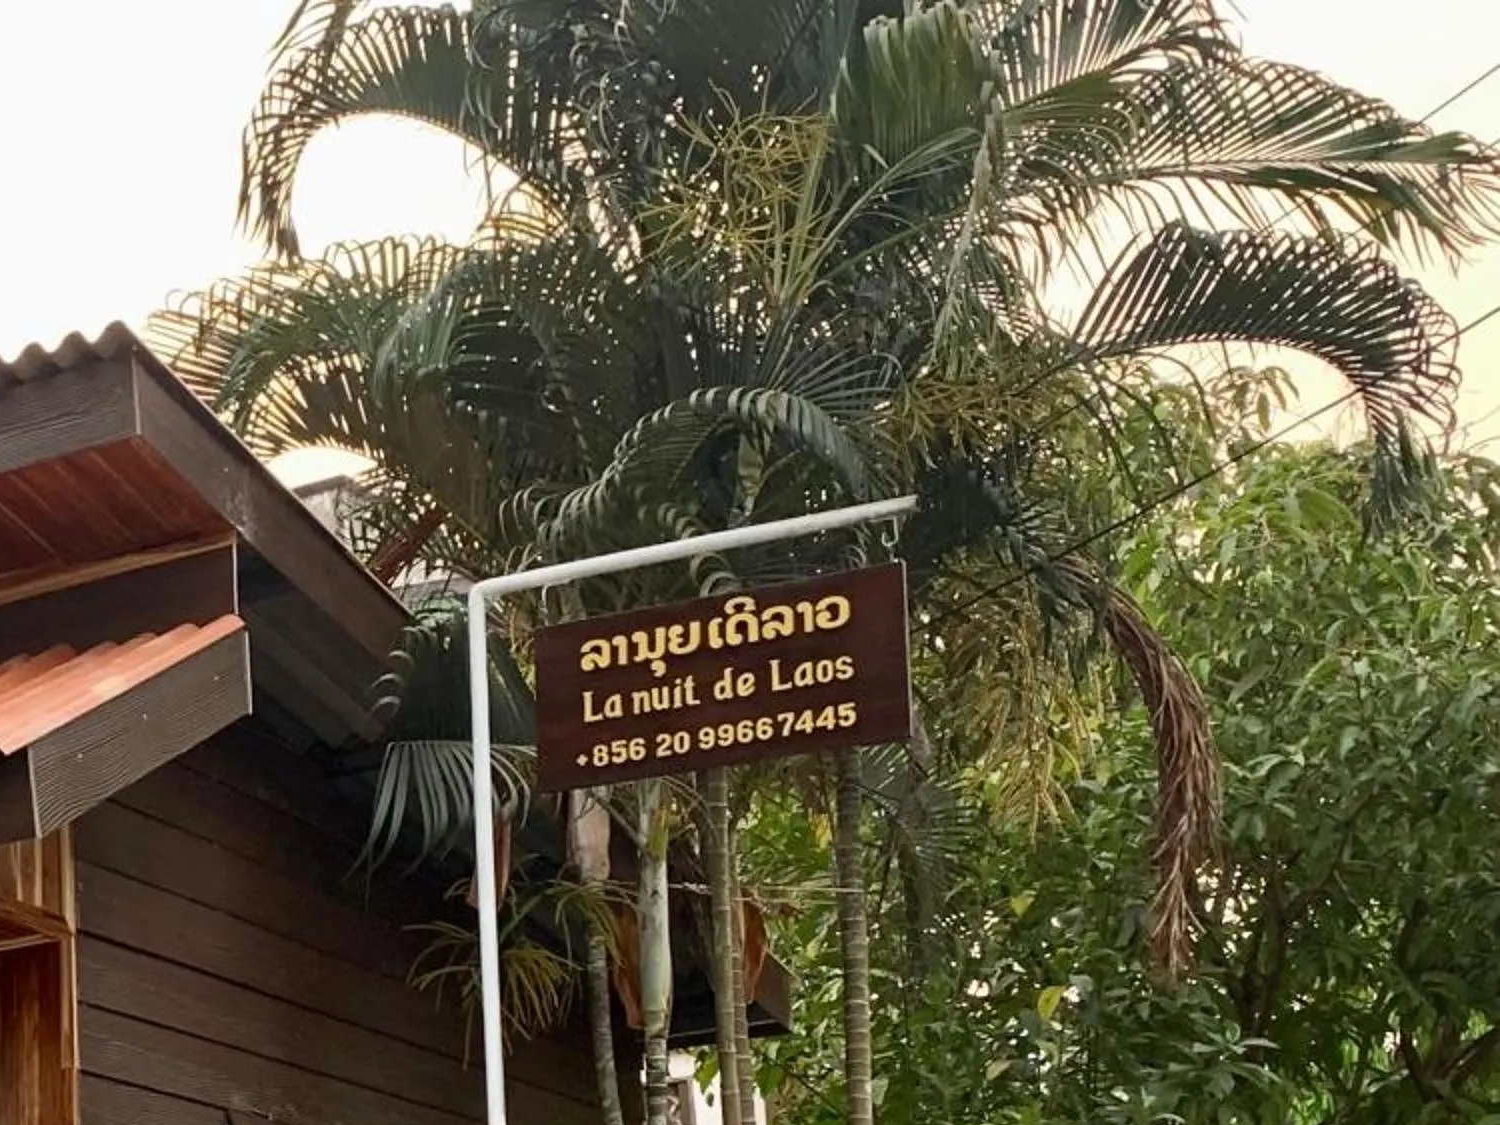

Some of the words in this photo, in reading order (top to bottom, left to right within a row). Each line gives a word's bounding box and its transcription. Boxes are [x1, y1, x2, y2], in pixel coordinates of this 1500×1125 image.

[582, 690, 624, 724] La
[631, 675, 701, 715] nuit
[712, 667, 756, 701] de
[769, 655, 855, 692] Laos
[575, 736, 647, 768] +856
[655, 731, 691, 758] 20
